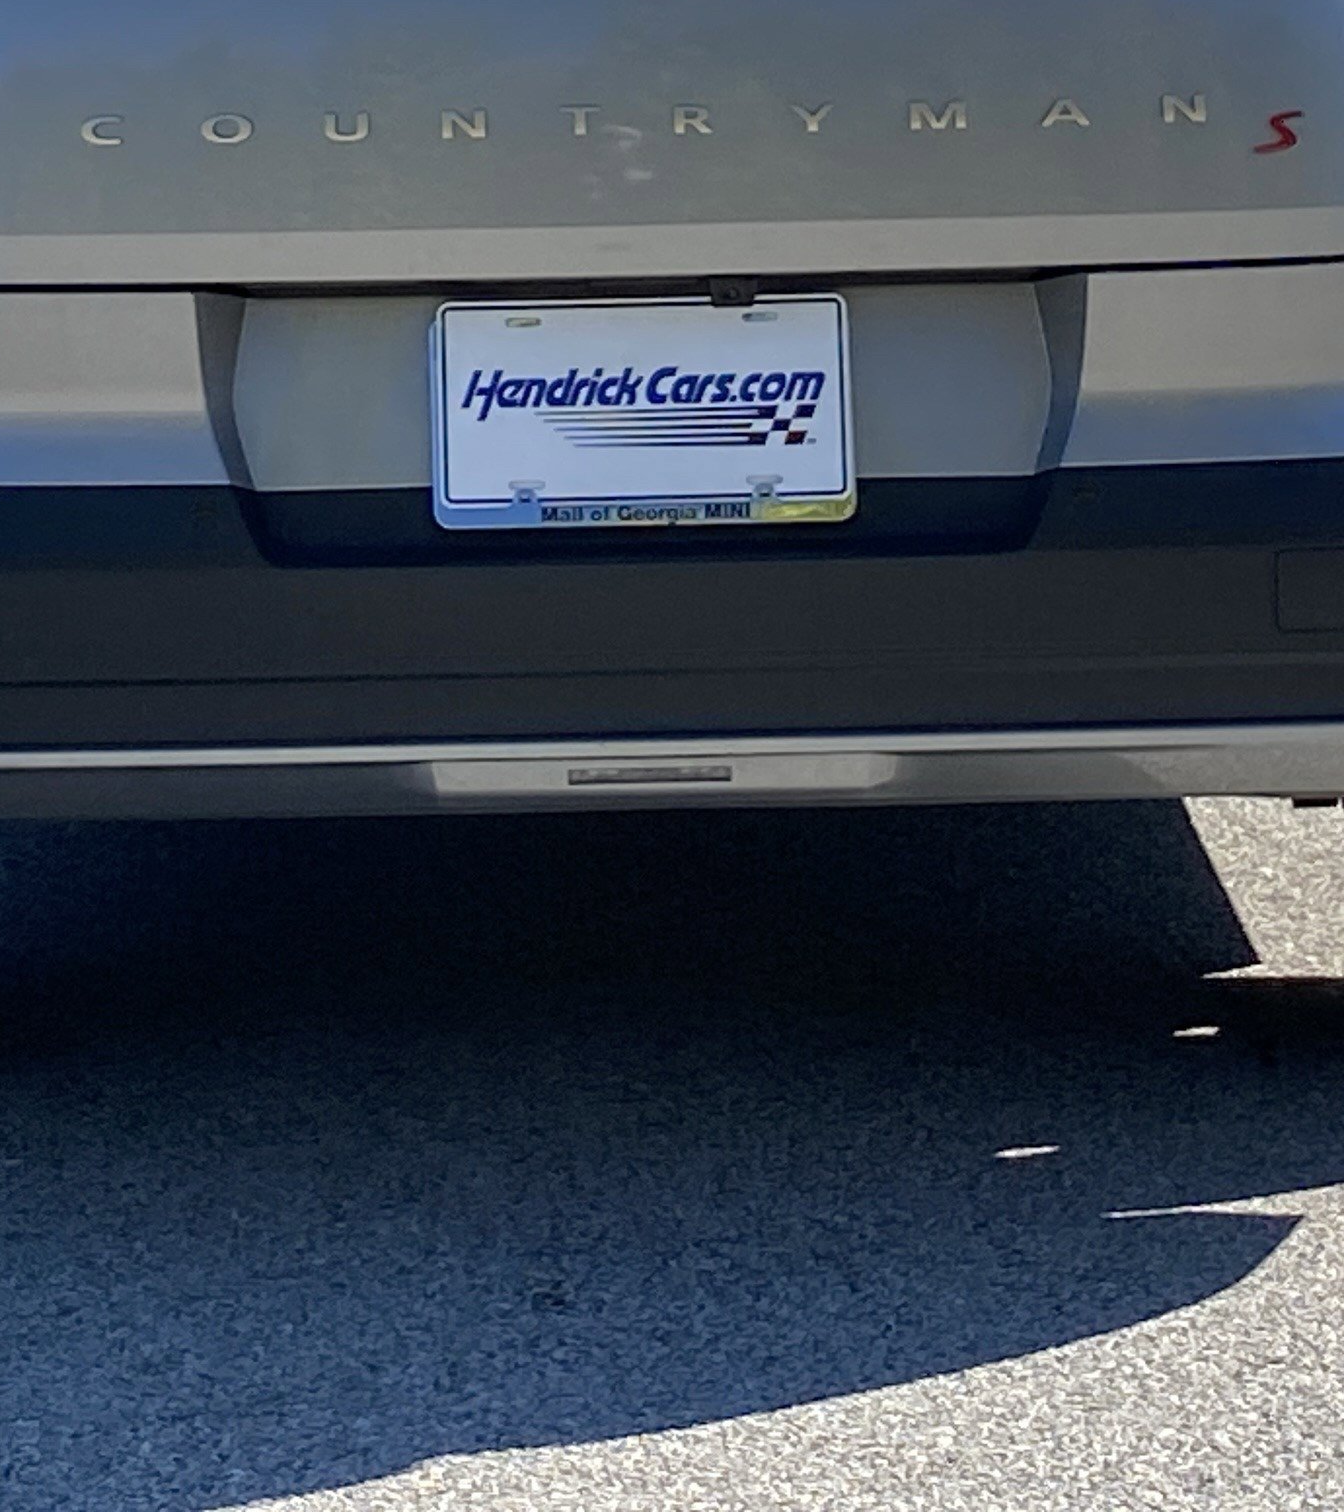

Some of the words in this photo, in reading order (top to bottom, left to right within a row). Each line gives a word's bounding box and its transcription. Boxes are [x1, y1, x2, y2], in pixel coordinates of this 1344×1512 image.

[79, 93, 1208, 147] COUNTRYMAN
[1252, 109, 1303, 154] S
[540, 505, 584, 522] Mall
[590, 505, 610, 522] of
[616, 503, 699, 523] Georgia
[704, 501, 751, 519] MINI
